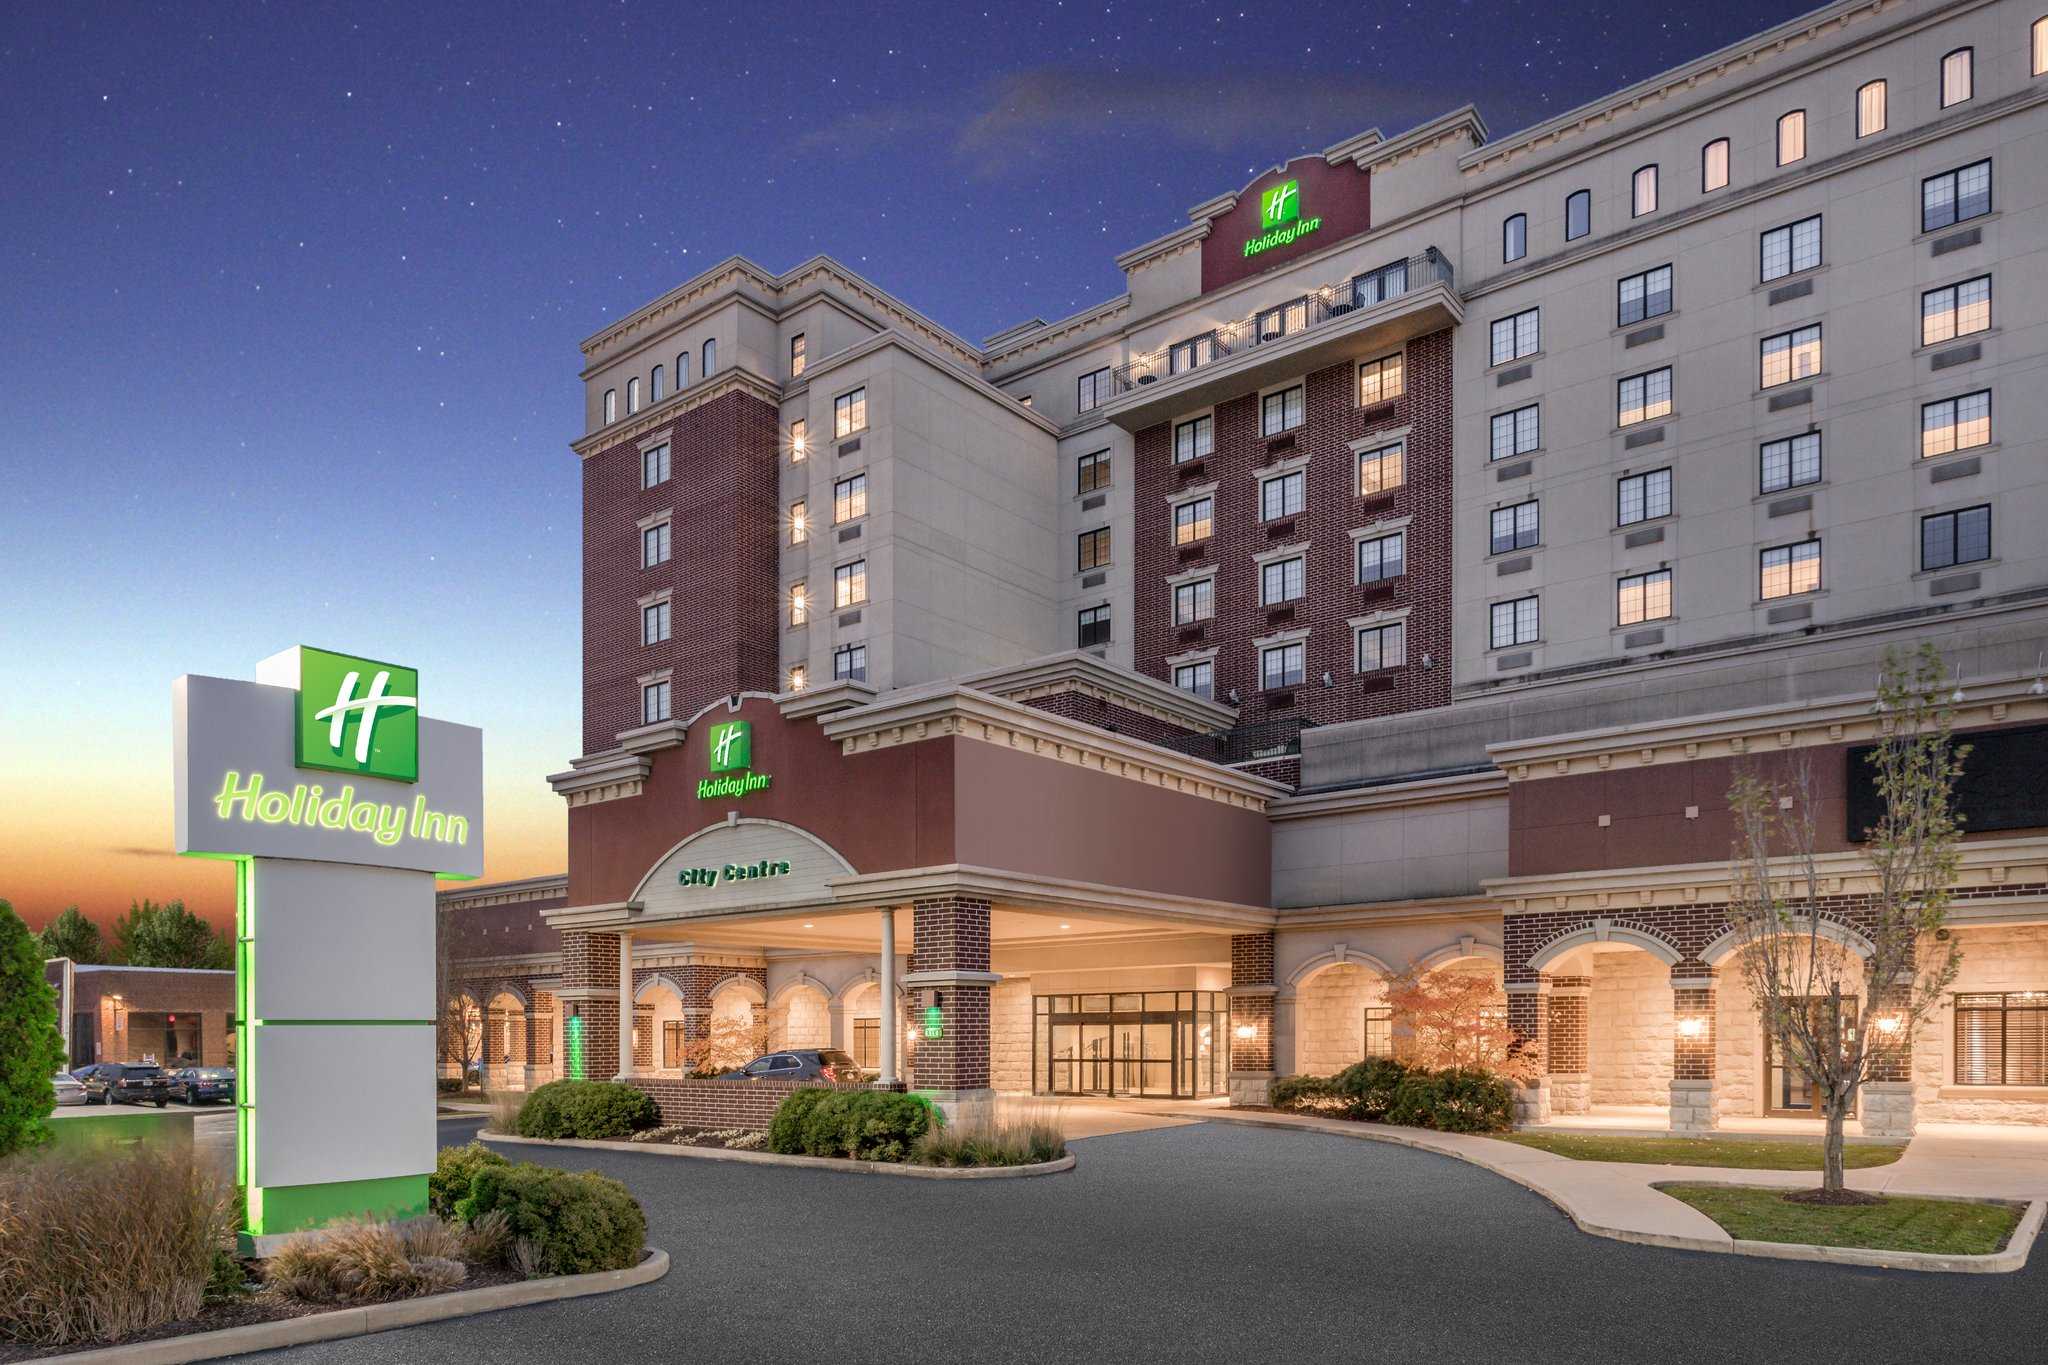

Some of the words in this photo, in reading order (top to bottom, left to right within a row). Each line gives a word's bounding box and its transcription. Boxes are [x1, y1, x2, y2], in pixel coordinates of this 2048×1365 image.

[1243, 227, 1296, 257] Holiday
[1296, 218, 1318, 237] Inn
[314, 671, 416, 763] H
[697, 775, 745, 800] Holiday
[745, 771, 766, 791] Inn
[215, 771, 407, 846] Holiday
[409, 795, 469, 845] Inn
[678, 868, 720, 888] City
[723, 859, 792, 882] Centre
